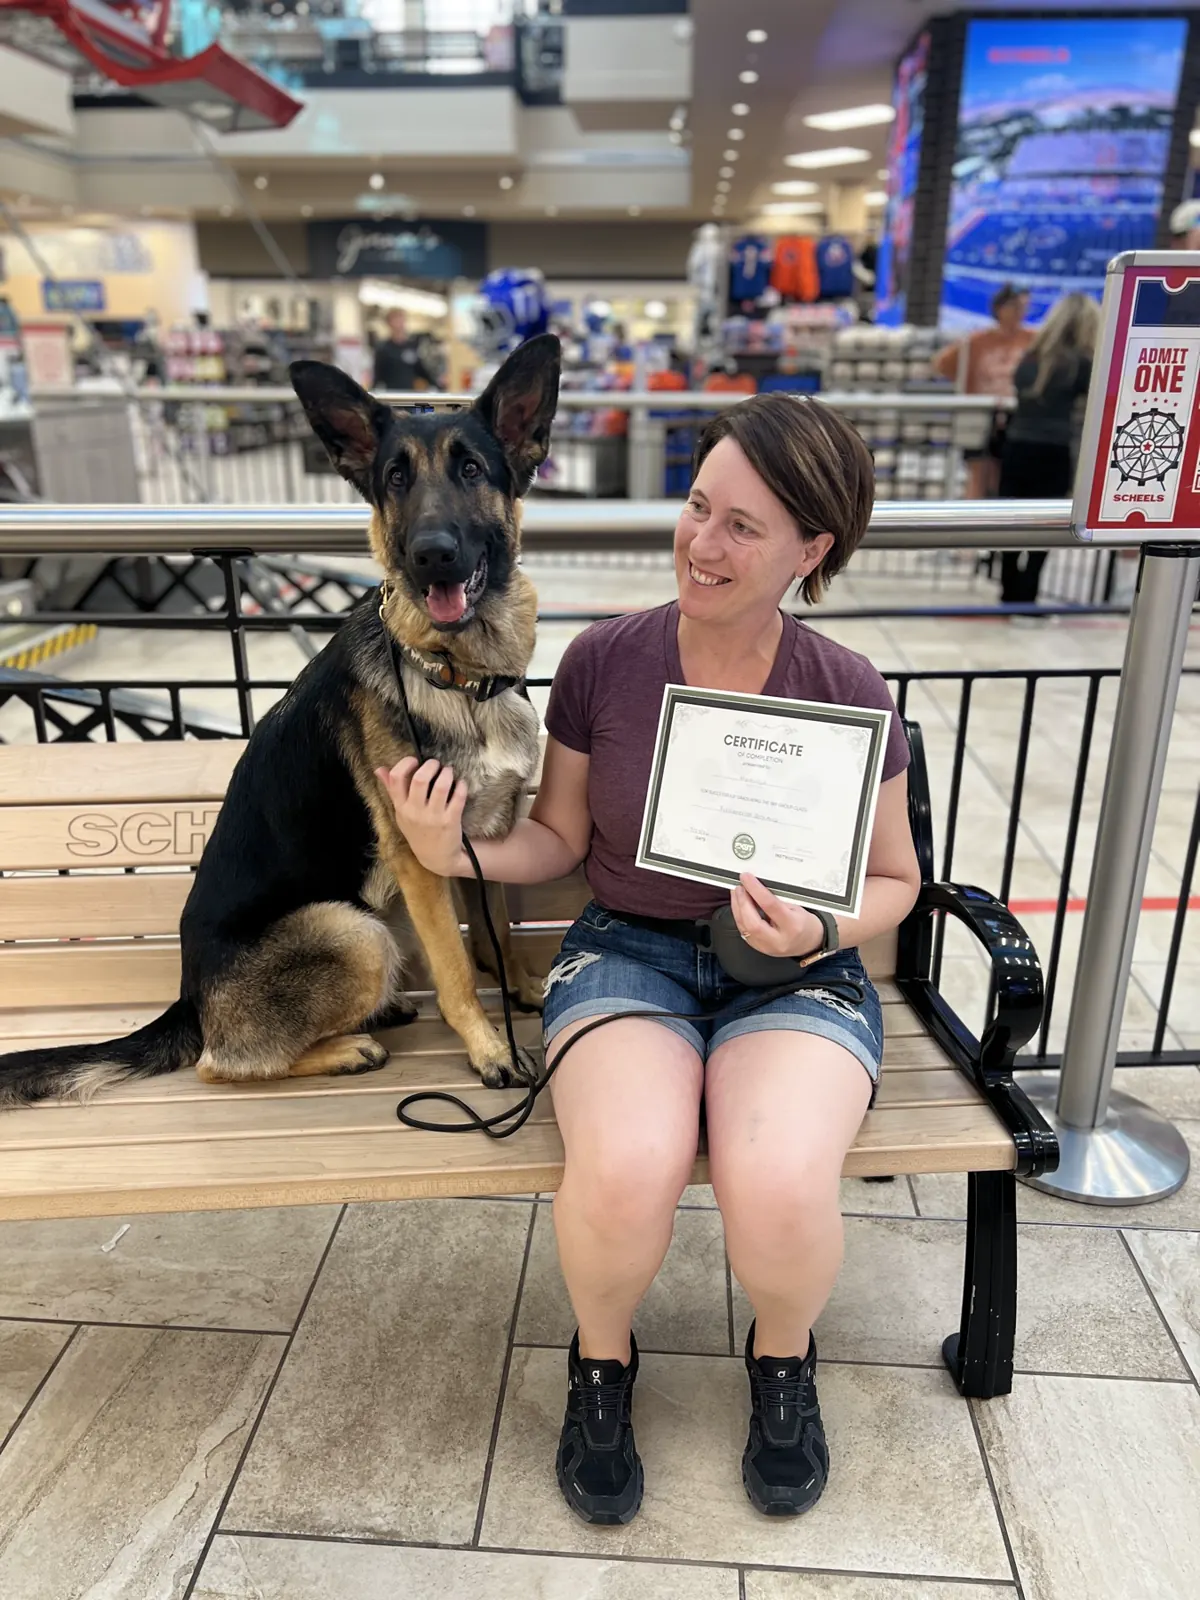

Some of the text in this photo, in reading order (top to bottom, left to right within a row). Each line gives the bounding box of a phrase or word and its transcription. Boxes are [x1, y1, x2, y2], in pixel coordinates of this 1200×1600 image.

[1137, 347, 1189, 364] ADMIT
[1133, 364, 1186, 393] ONE
[1113, 493, 1165, 502] SCHEELS
[723, 734, 804, 757] CERTIFICATE
[746, 752, 783, 764] COMPLETION
